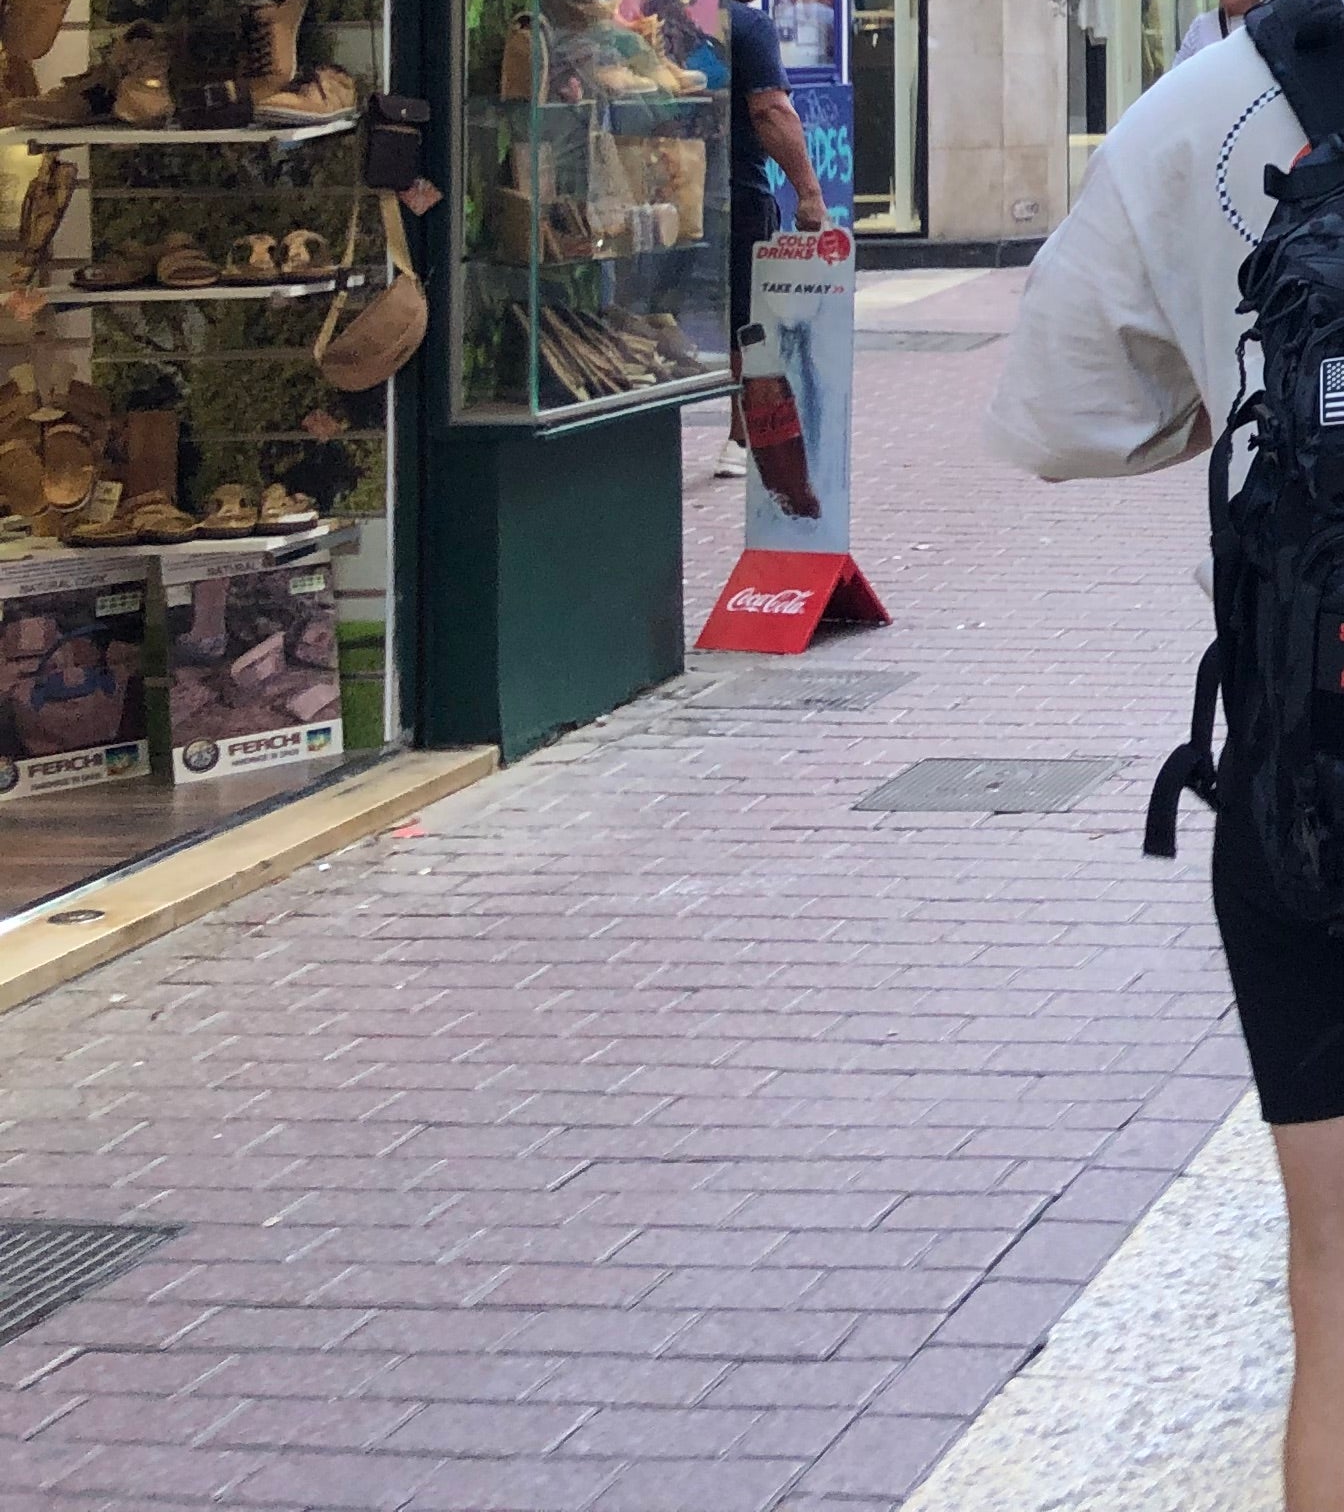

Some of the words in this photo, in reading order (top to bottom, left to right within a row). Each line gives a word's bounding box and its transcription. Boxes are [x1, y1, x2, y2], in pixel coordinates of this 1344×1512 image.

[777, 234, 818, 248] COLD
[756, 246, 815, 260] DRINKS
[761, 282, 793, 294] TAKE
[794, 283, 832, 295] AWAY
